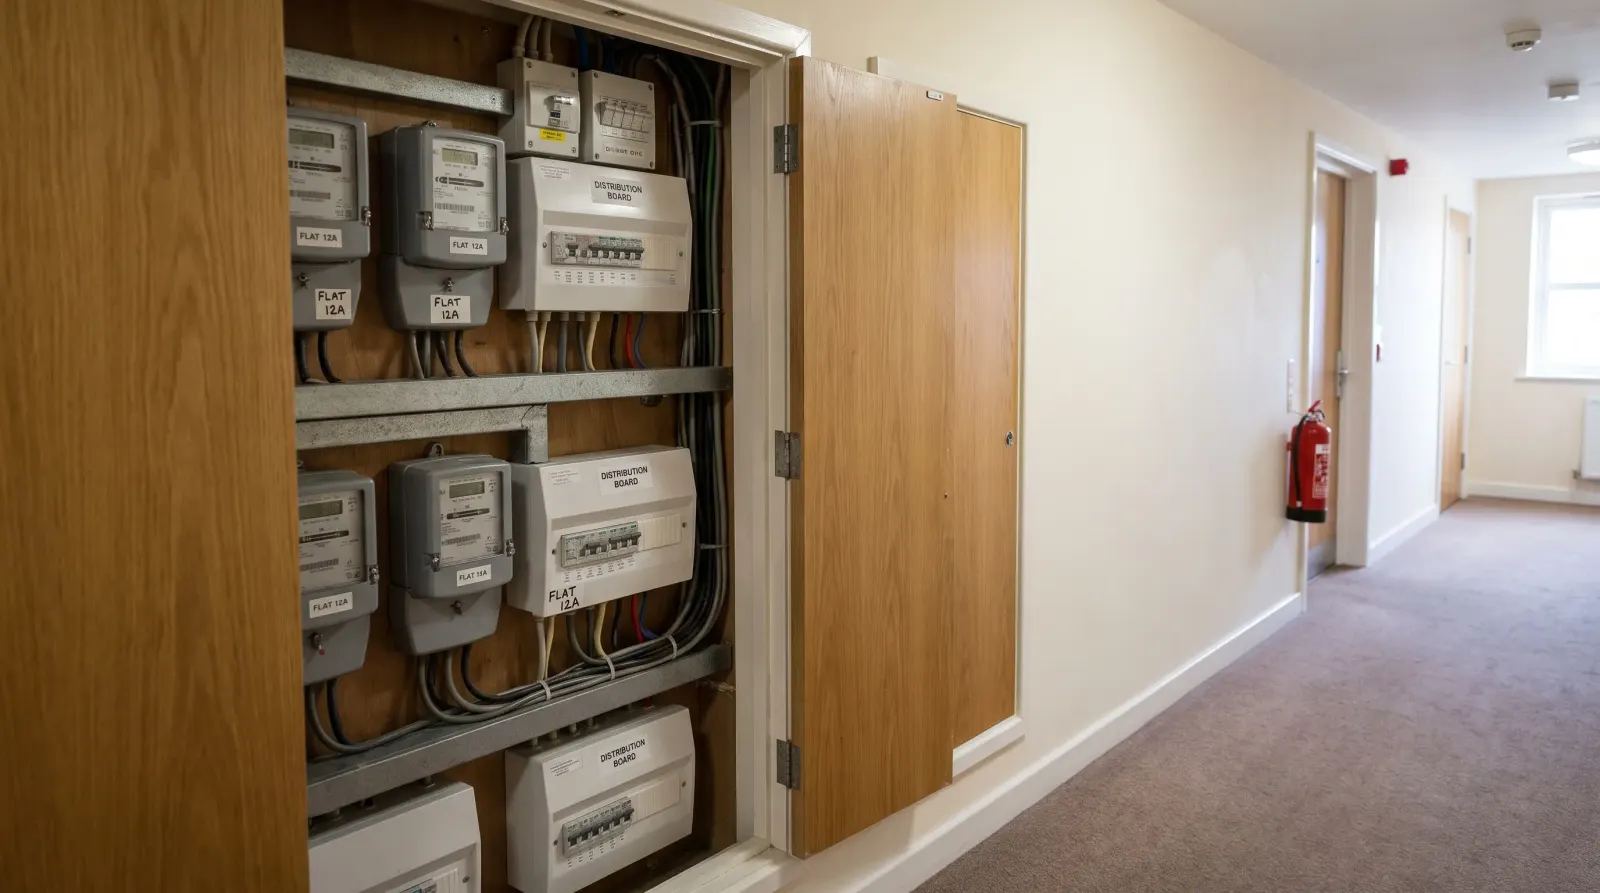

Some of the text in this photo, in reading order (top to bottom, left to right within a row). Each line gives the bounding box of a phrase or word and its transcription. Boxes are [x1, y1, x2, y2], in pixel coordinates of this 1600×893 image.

[594, 180, 643, 194] DISTRIBUTION
[607, 191, 632, 202] BOARD
[299, 231, 338, 242] FLAT 12A
[452, 241, 469, 249] FLAT
[318, 290, 347, 302] FLAT
[434, 296, 462, 308] FLAT
[325, 304, 346, 316] 12A
[442, 310, 460, 320] 12A
[601, 466, 648, 480] DISTRIBUTION
[614, 478, 639, 488] BOARD
[459, 572, 475, 581] FLAT
[548, 586, 577, 602] FLAT
[312, 598, 349, 612] FLAT 12A
[560, 597, 580, 611] 12A
[600, 738, 646, 763] DISTRIBUTION
[613, 752, 636, 768] BOARD
